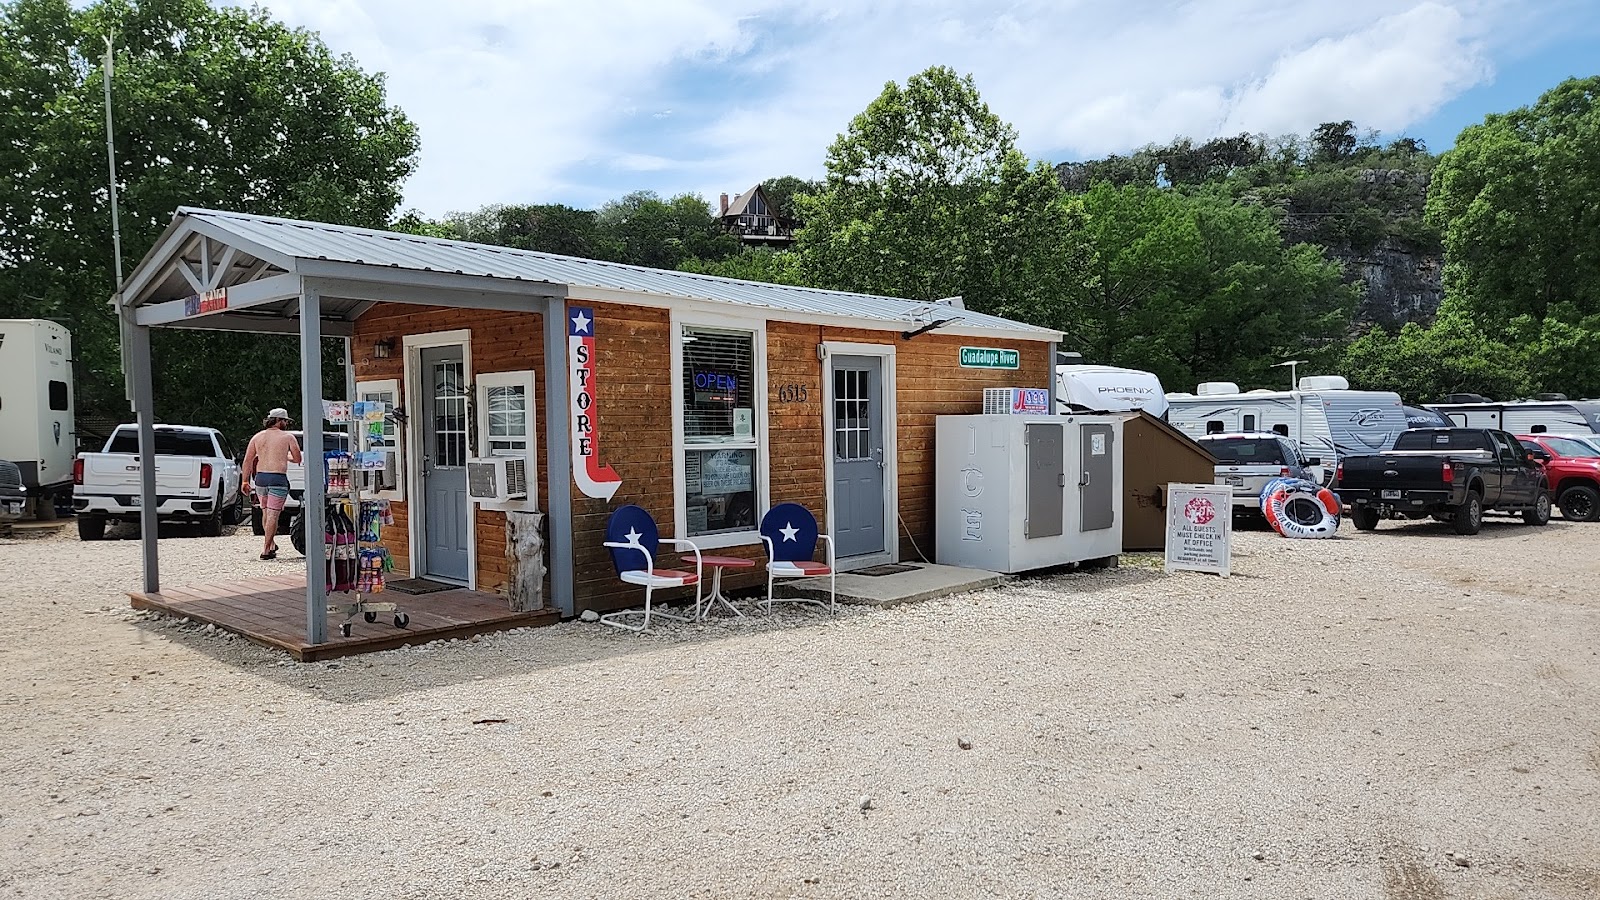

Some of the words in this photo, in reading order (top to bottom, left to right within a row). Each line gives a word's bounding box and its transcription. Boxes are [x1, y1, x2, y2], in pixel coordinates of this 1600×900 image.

[962, 348, 998, 366] Guadalupe
[999, 350, 1016, 364] River
[695, 373, 736, 390] OPEN
[576, 345, 592, 456] STORE
[779, 383, 807, 403] 6515
[1026, 391, 1046, 403] ICE
[1273, 500, 1287, 523] RIVER
[1284, 522, 1305, 534] RUN
